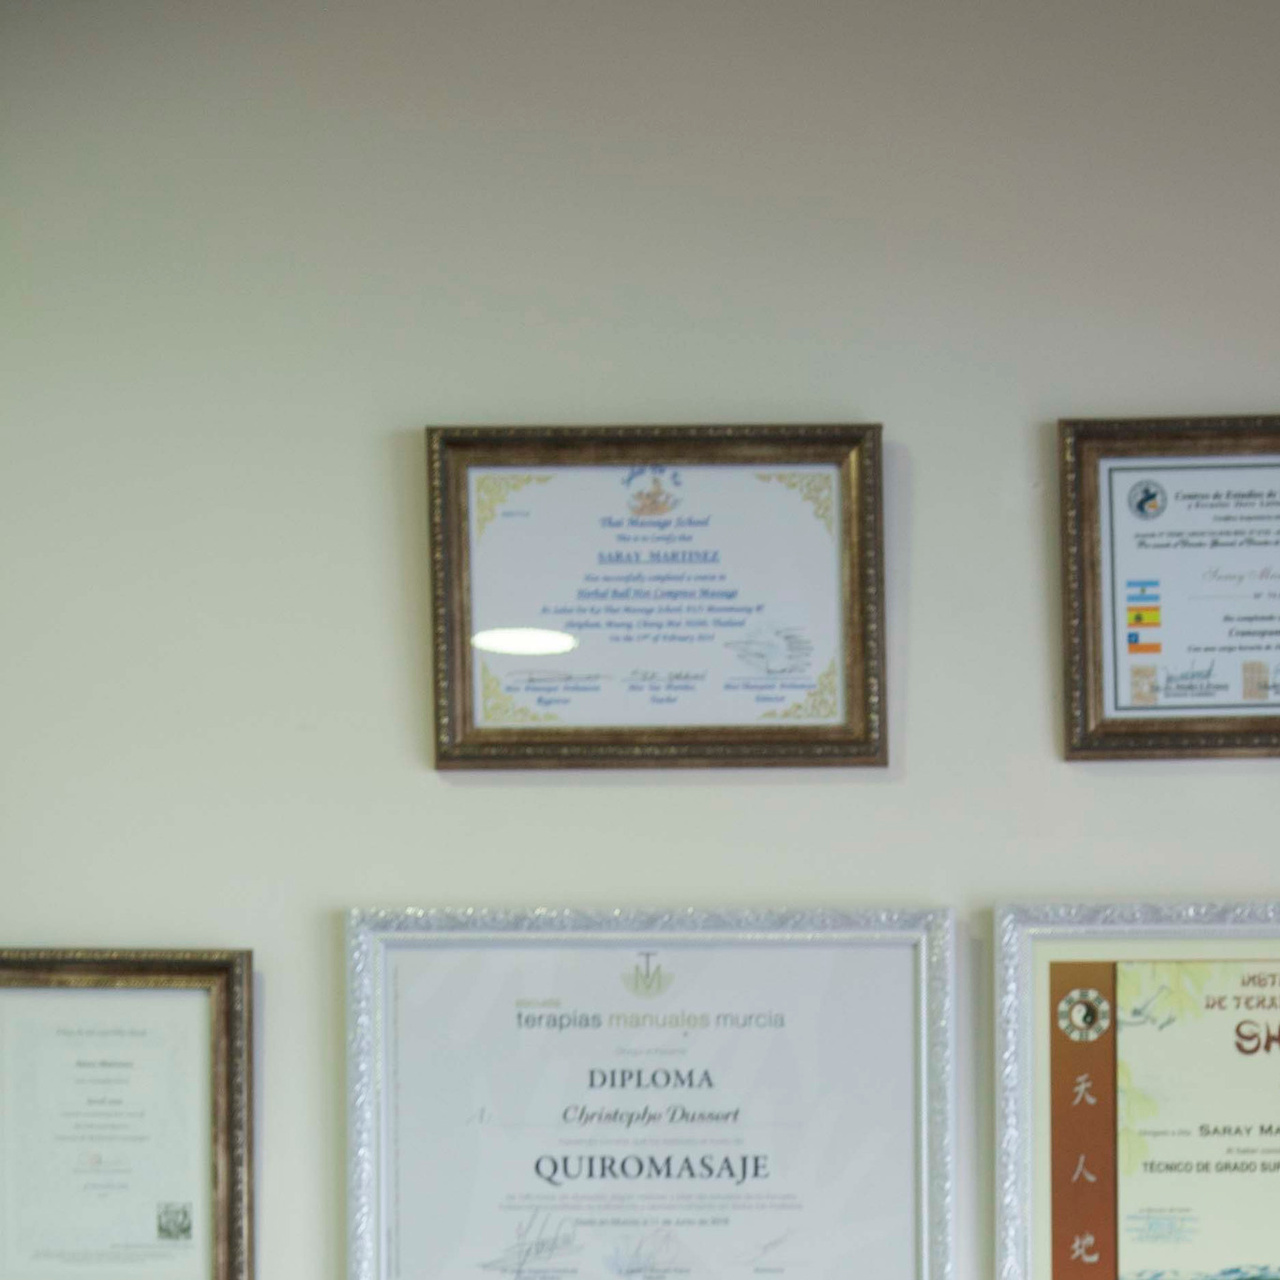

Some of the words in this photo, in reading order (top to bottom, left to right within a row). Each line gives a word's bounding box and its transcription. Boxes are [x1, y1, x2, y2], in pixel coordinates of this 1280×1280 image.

[675, 514, 712, 528] School
[1204, 995, 1229, 1011] DE
[516, 1010, 603, 1033] terapias
[607, 1010, 711, 1030] manuales
[714, 1010, 786, 1030] murcia
[588, 1067, 715, 1090] DIPLOMA
[533, 1153, 771, 1188] QUIROMASAJE
[1142, 1159, 1193, 1174] TÉCNICO
[1196, 1160, 1212, 1173] DE
[1214, 1160, 1257, 1173] GRADO
